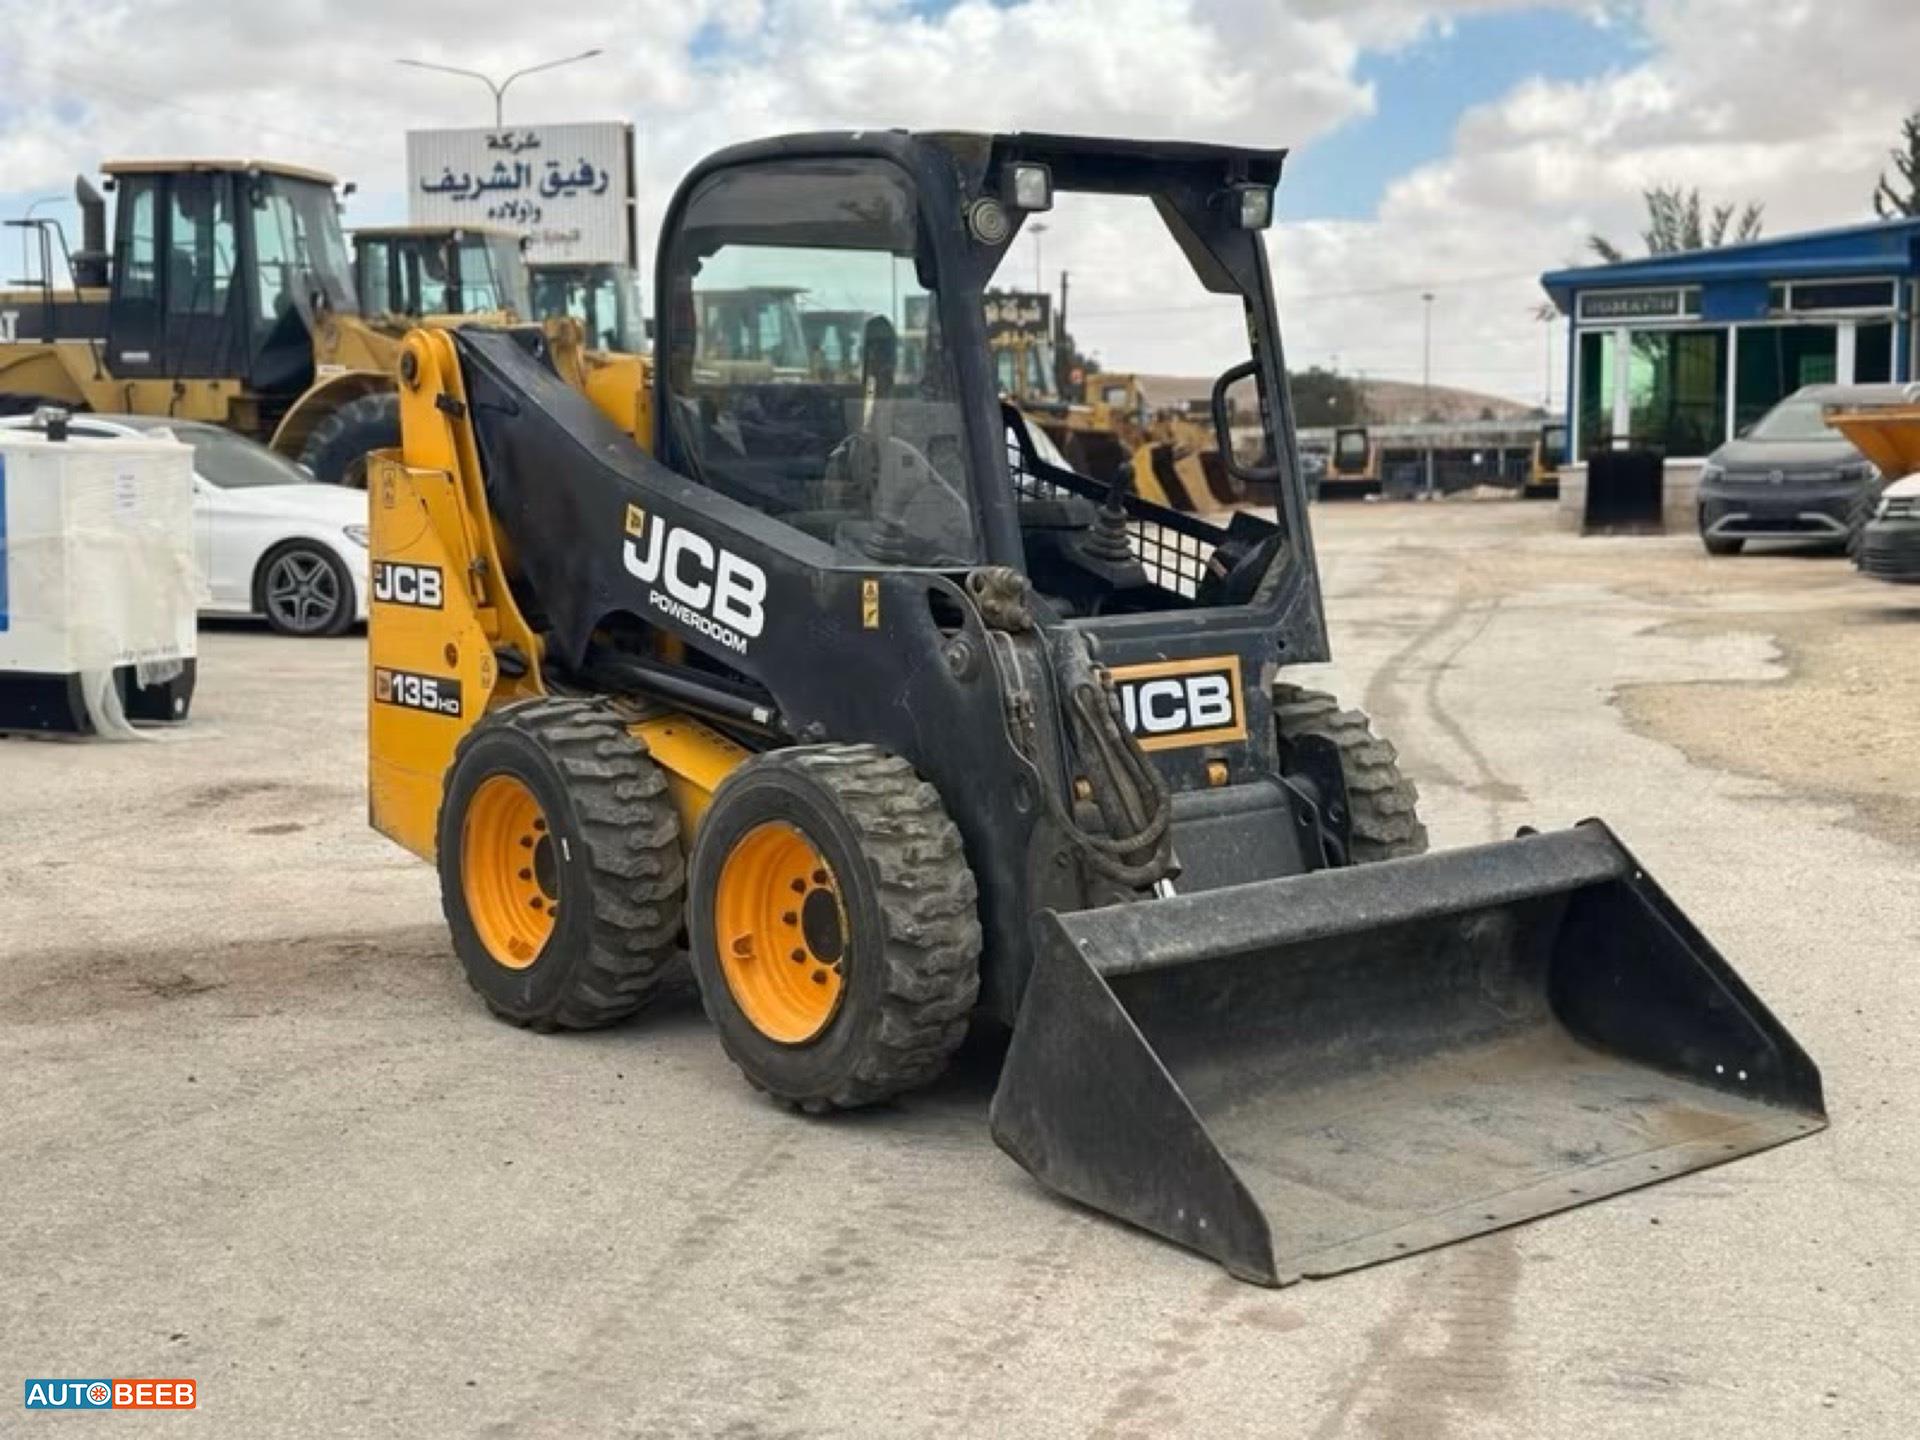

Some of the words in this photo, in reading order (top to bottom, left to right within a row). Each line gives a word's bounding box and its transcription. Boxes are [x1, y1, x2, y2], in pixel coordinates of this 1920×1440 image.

[486, 132, 541, 154] شركة
[420, 160, 532, 201] الشريف
[540, 158, 609, 198] رفيق
[375, 564, 442, 606] JCB
[624, 515, 767, 637] JCB
